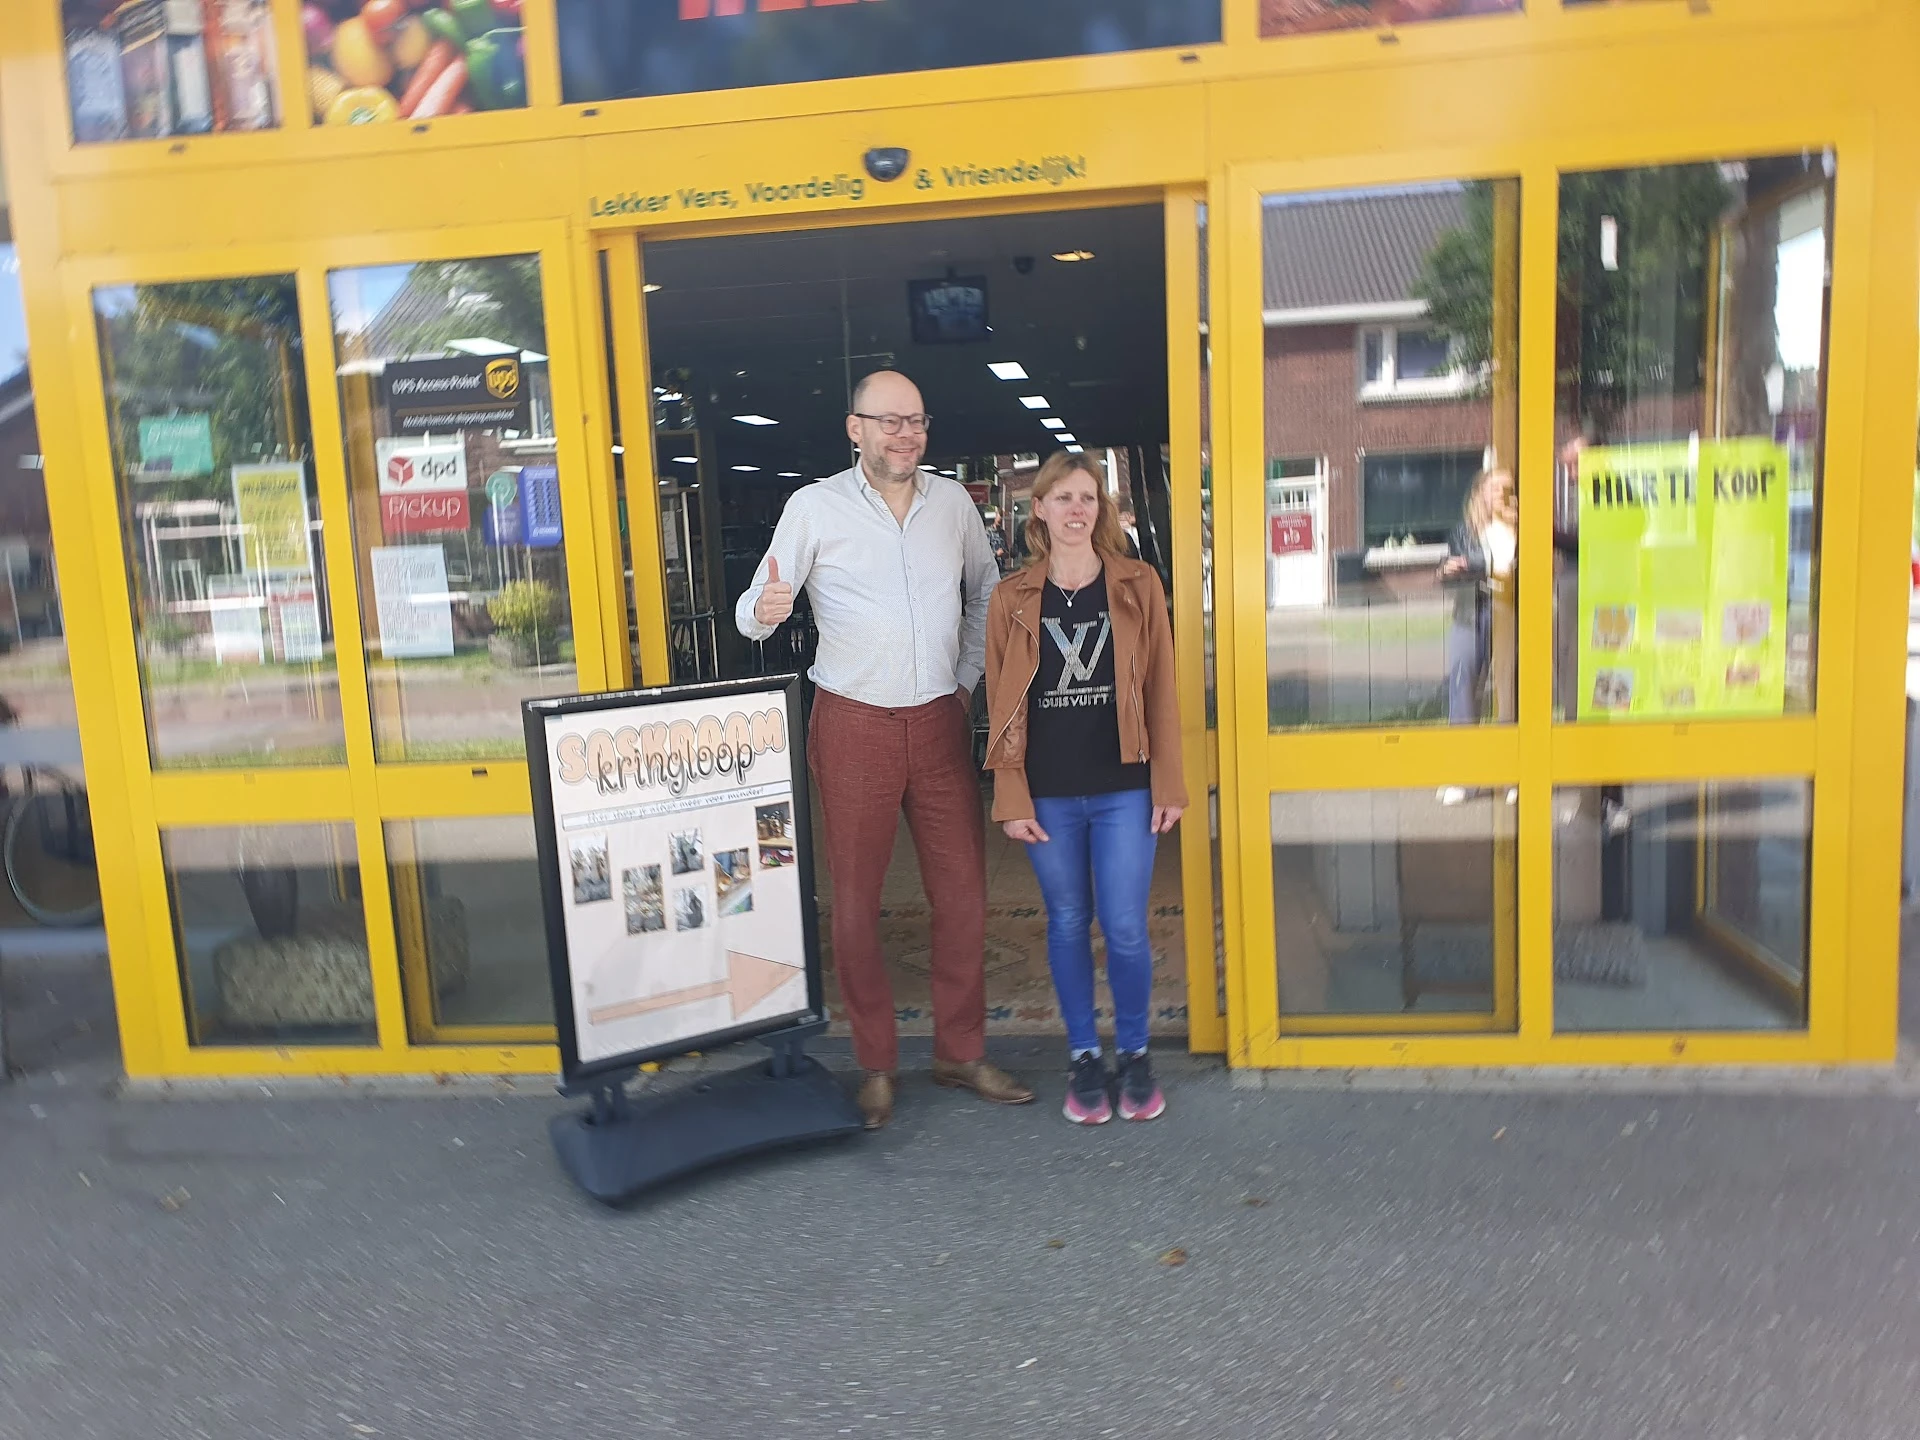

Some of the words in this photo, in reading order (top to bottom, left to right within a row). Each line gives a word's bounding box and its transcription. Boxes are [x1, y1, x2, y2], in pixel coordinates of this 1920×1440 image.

[589, 191, 672, 218] Lekker
[676, 187, 740, 210] Vers,
[744, 173, 866, 202] Voordelig
[913, 168, 935, 191] &
[940, 154, 1087, 187] Vriendelijk!
[421, 456, 457, 483] dpd
[388, 494, 461, 521] Pickup
[595, 738, 754, 795] kringloop
